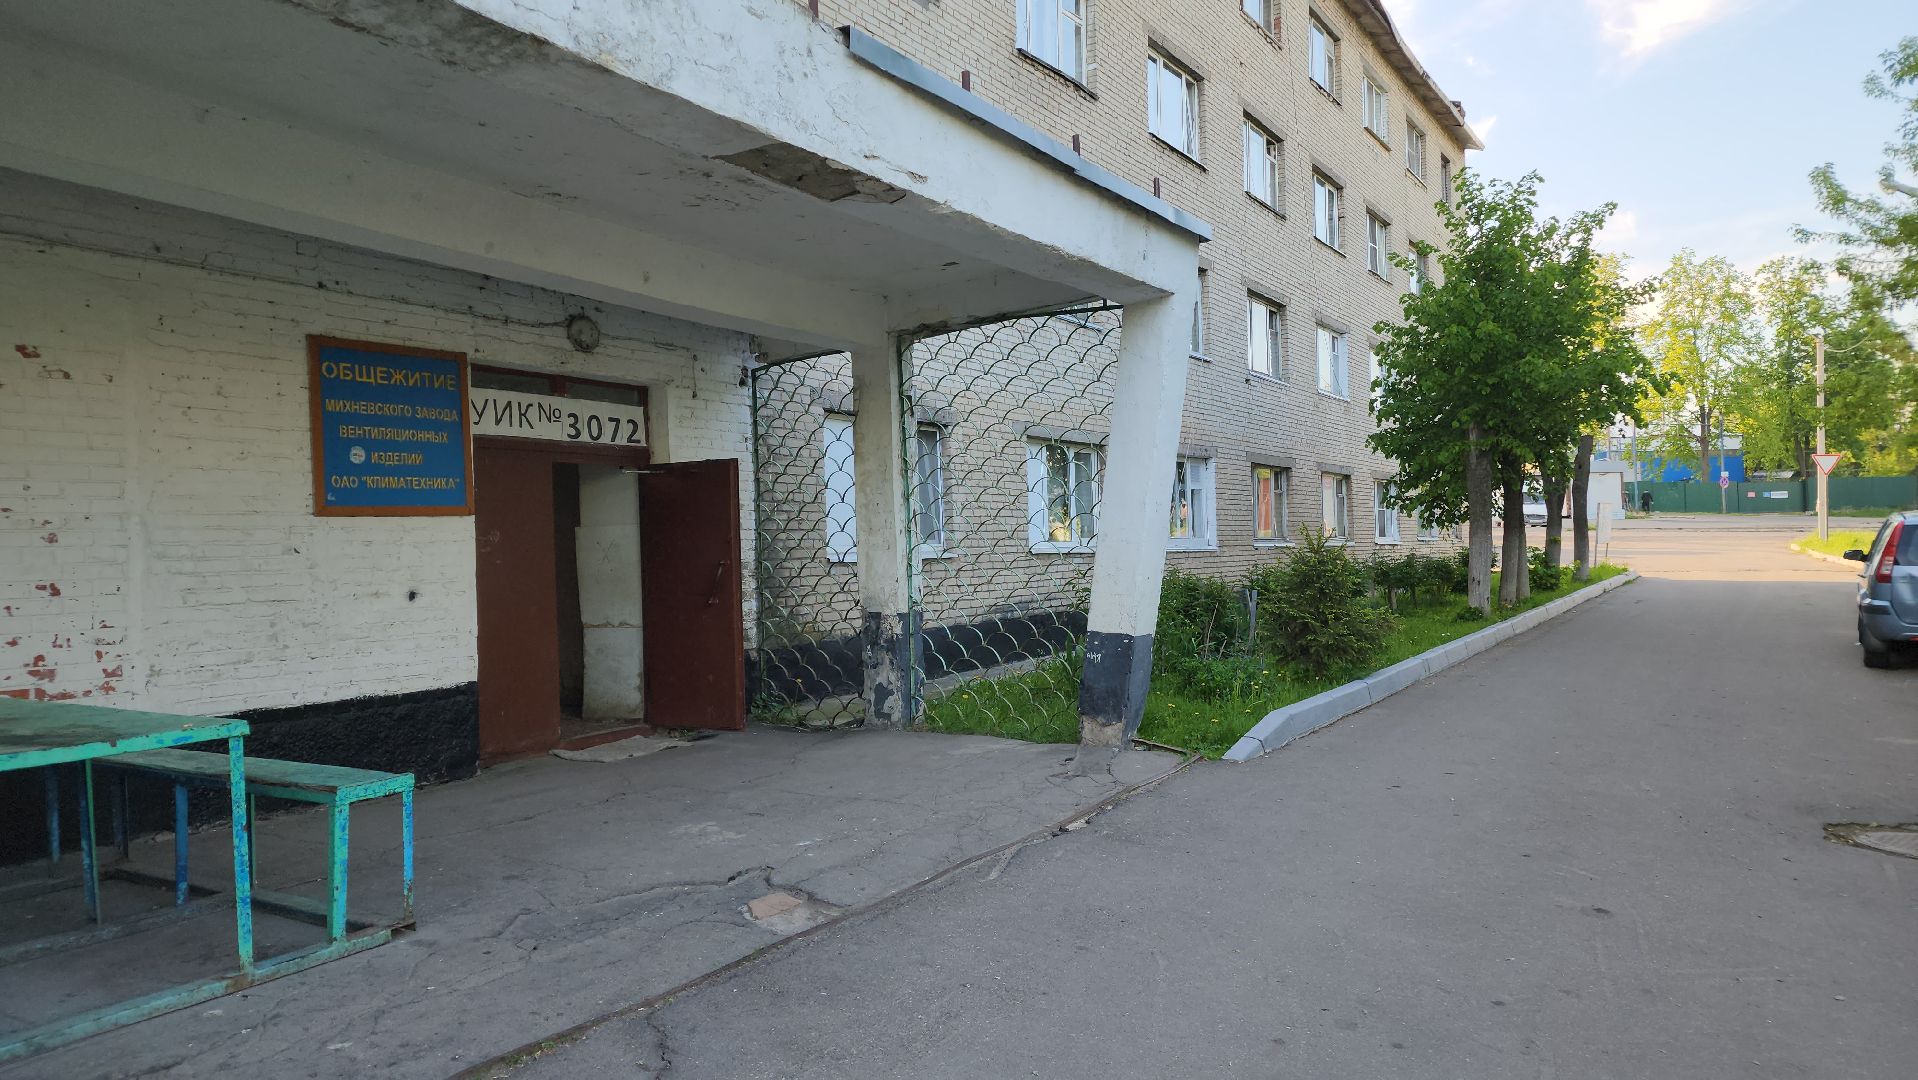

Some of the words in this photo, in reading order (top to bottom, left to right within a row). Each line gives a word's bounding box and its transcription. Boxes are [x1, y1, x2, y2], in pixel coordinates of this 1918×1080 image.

[321, 361, 457, 391] ОБЩЕЖИТИЕ
[325, 399, 412, 417] МИХНЕВСКОГО
[415, 406, 459, 421] ЗАВОДА
[339, 424, 449, 443] ВЕНТИЛЯЦИОННЫХ
[566, 412, 642, 444] 3072
[331, 475, 359, 488] ОАО
[361, 475, 460, 490] "КЛИМАТЕХНИКА"
